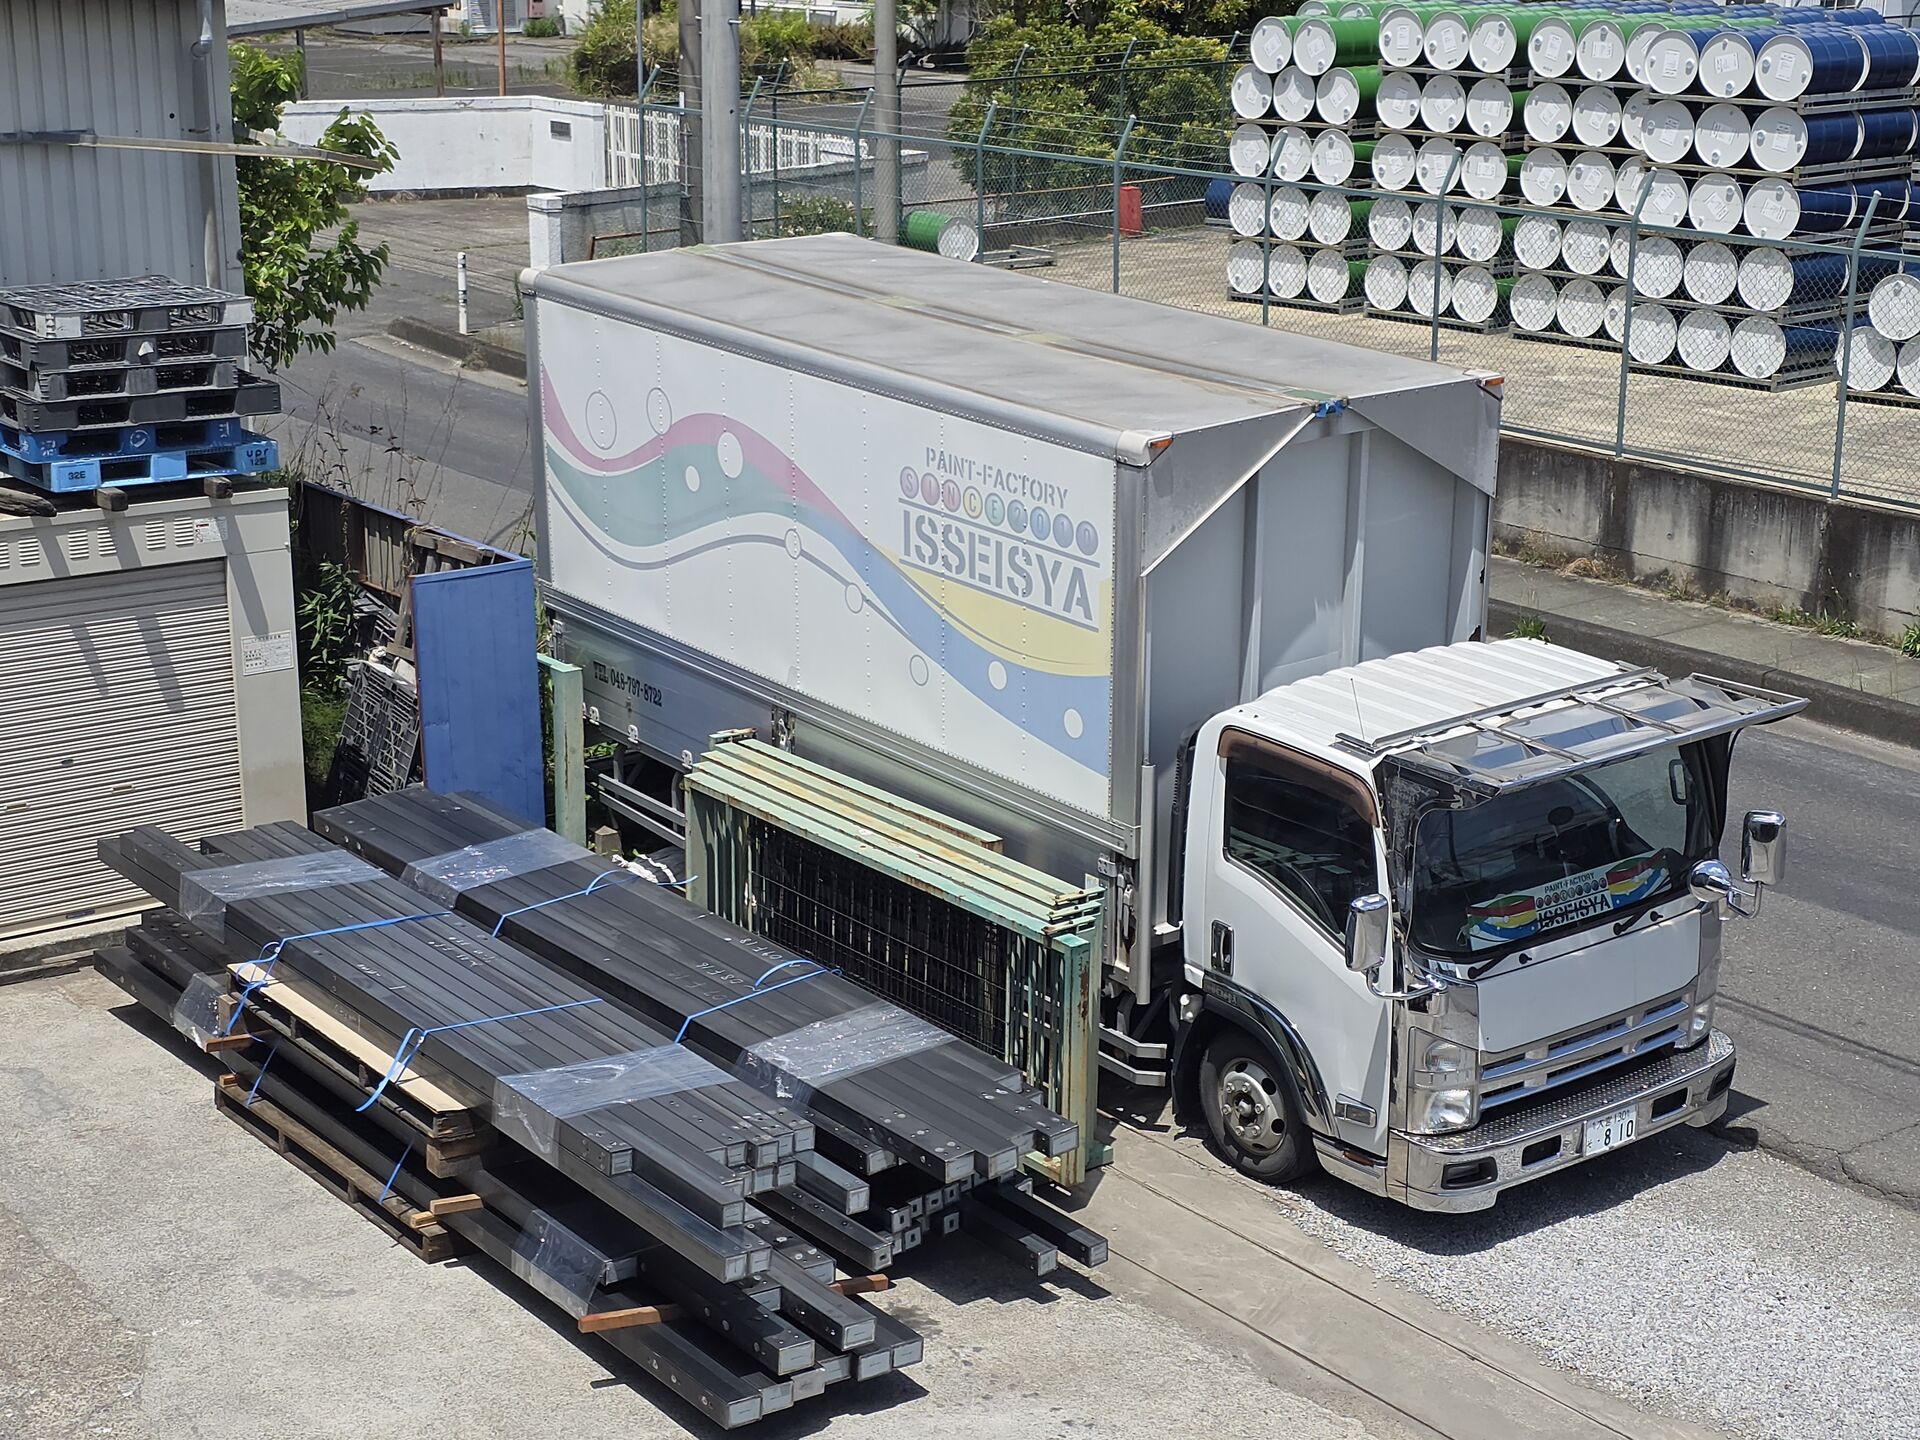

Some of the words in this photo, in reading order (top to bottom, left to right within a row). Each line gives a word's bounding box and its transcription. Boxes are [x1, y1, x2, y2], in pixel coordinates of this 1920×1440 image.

[246, 447, 269, 459] upr
[68, 470, 87, 481] 32E
[925, 446, 1069, 509] PAINT-FACTORY
[903, 509, 1093, 621] ISSEISYA
[610, 668, 663, 708] 048-797-8722
